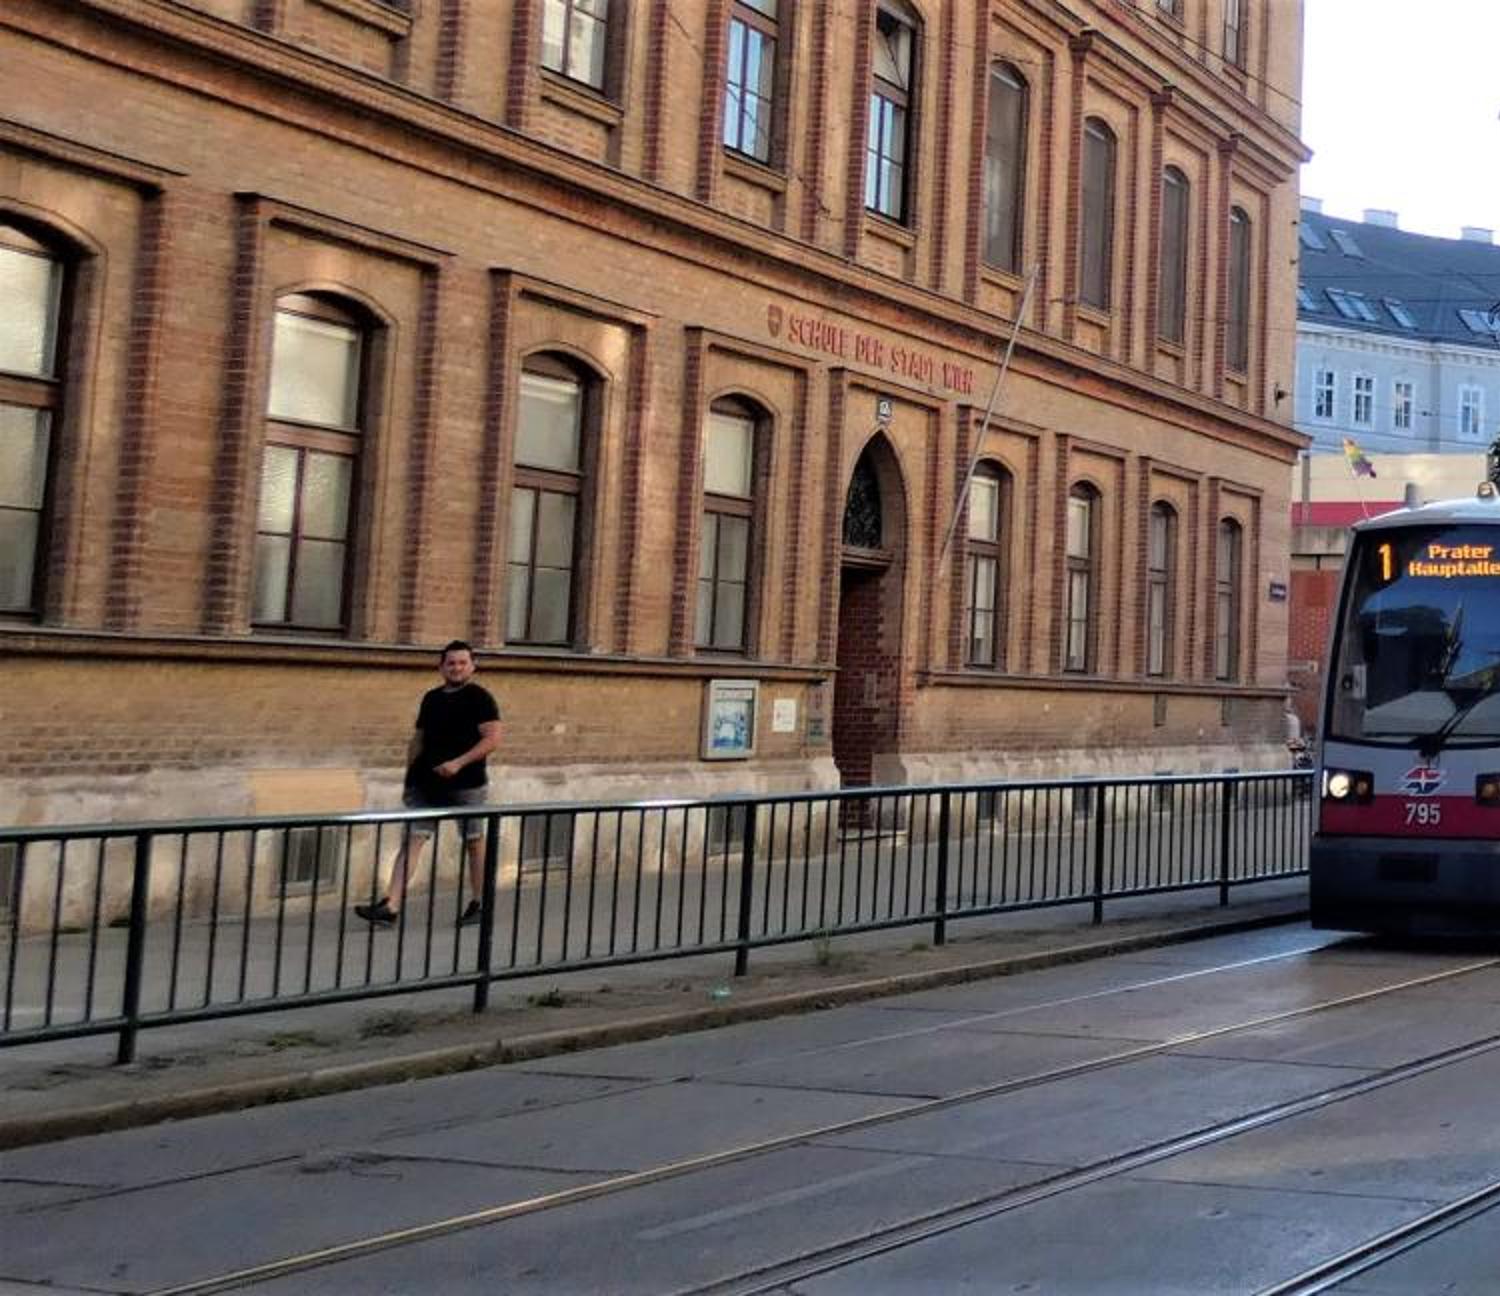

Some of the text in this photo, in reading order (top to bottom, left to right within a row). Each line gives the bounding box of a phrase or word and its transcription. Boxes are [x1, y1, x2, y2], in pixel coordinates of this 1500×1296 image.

[788, 315, 973, 394] SCHULE DER STADT WIEN
[1378, 543, 1392, 581] 1
[1427, 544, 1494, 560] Prater
[1405, 802, 1441, 825] 795
